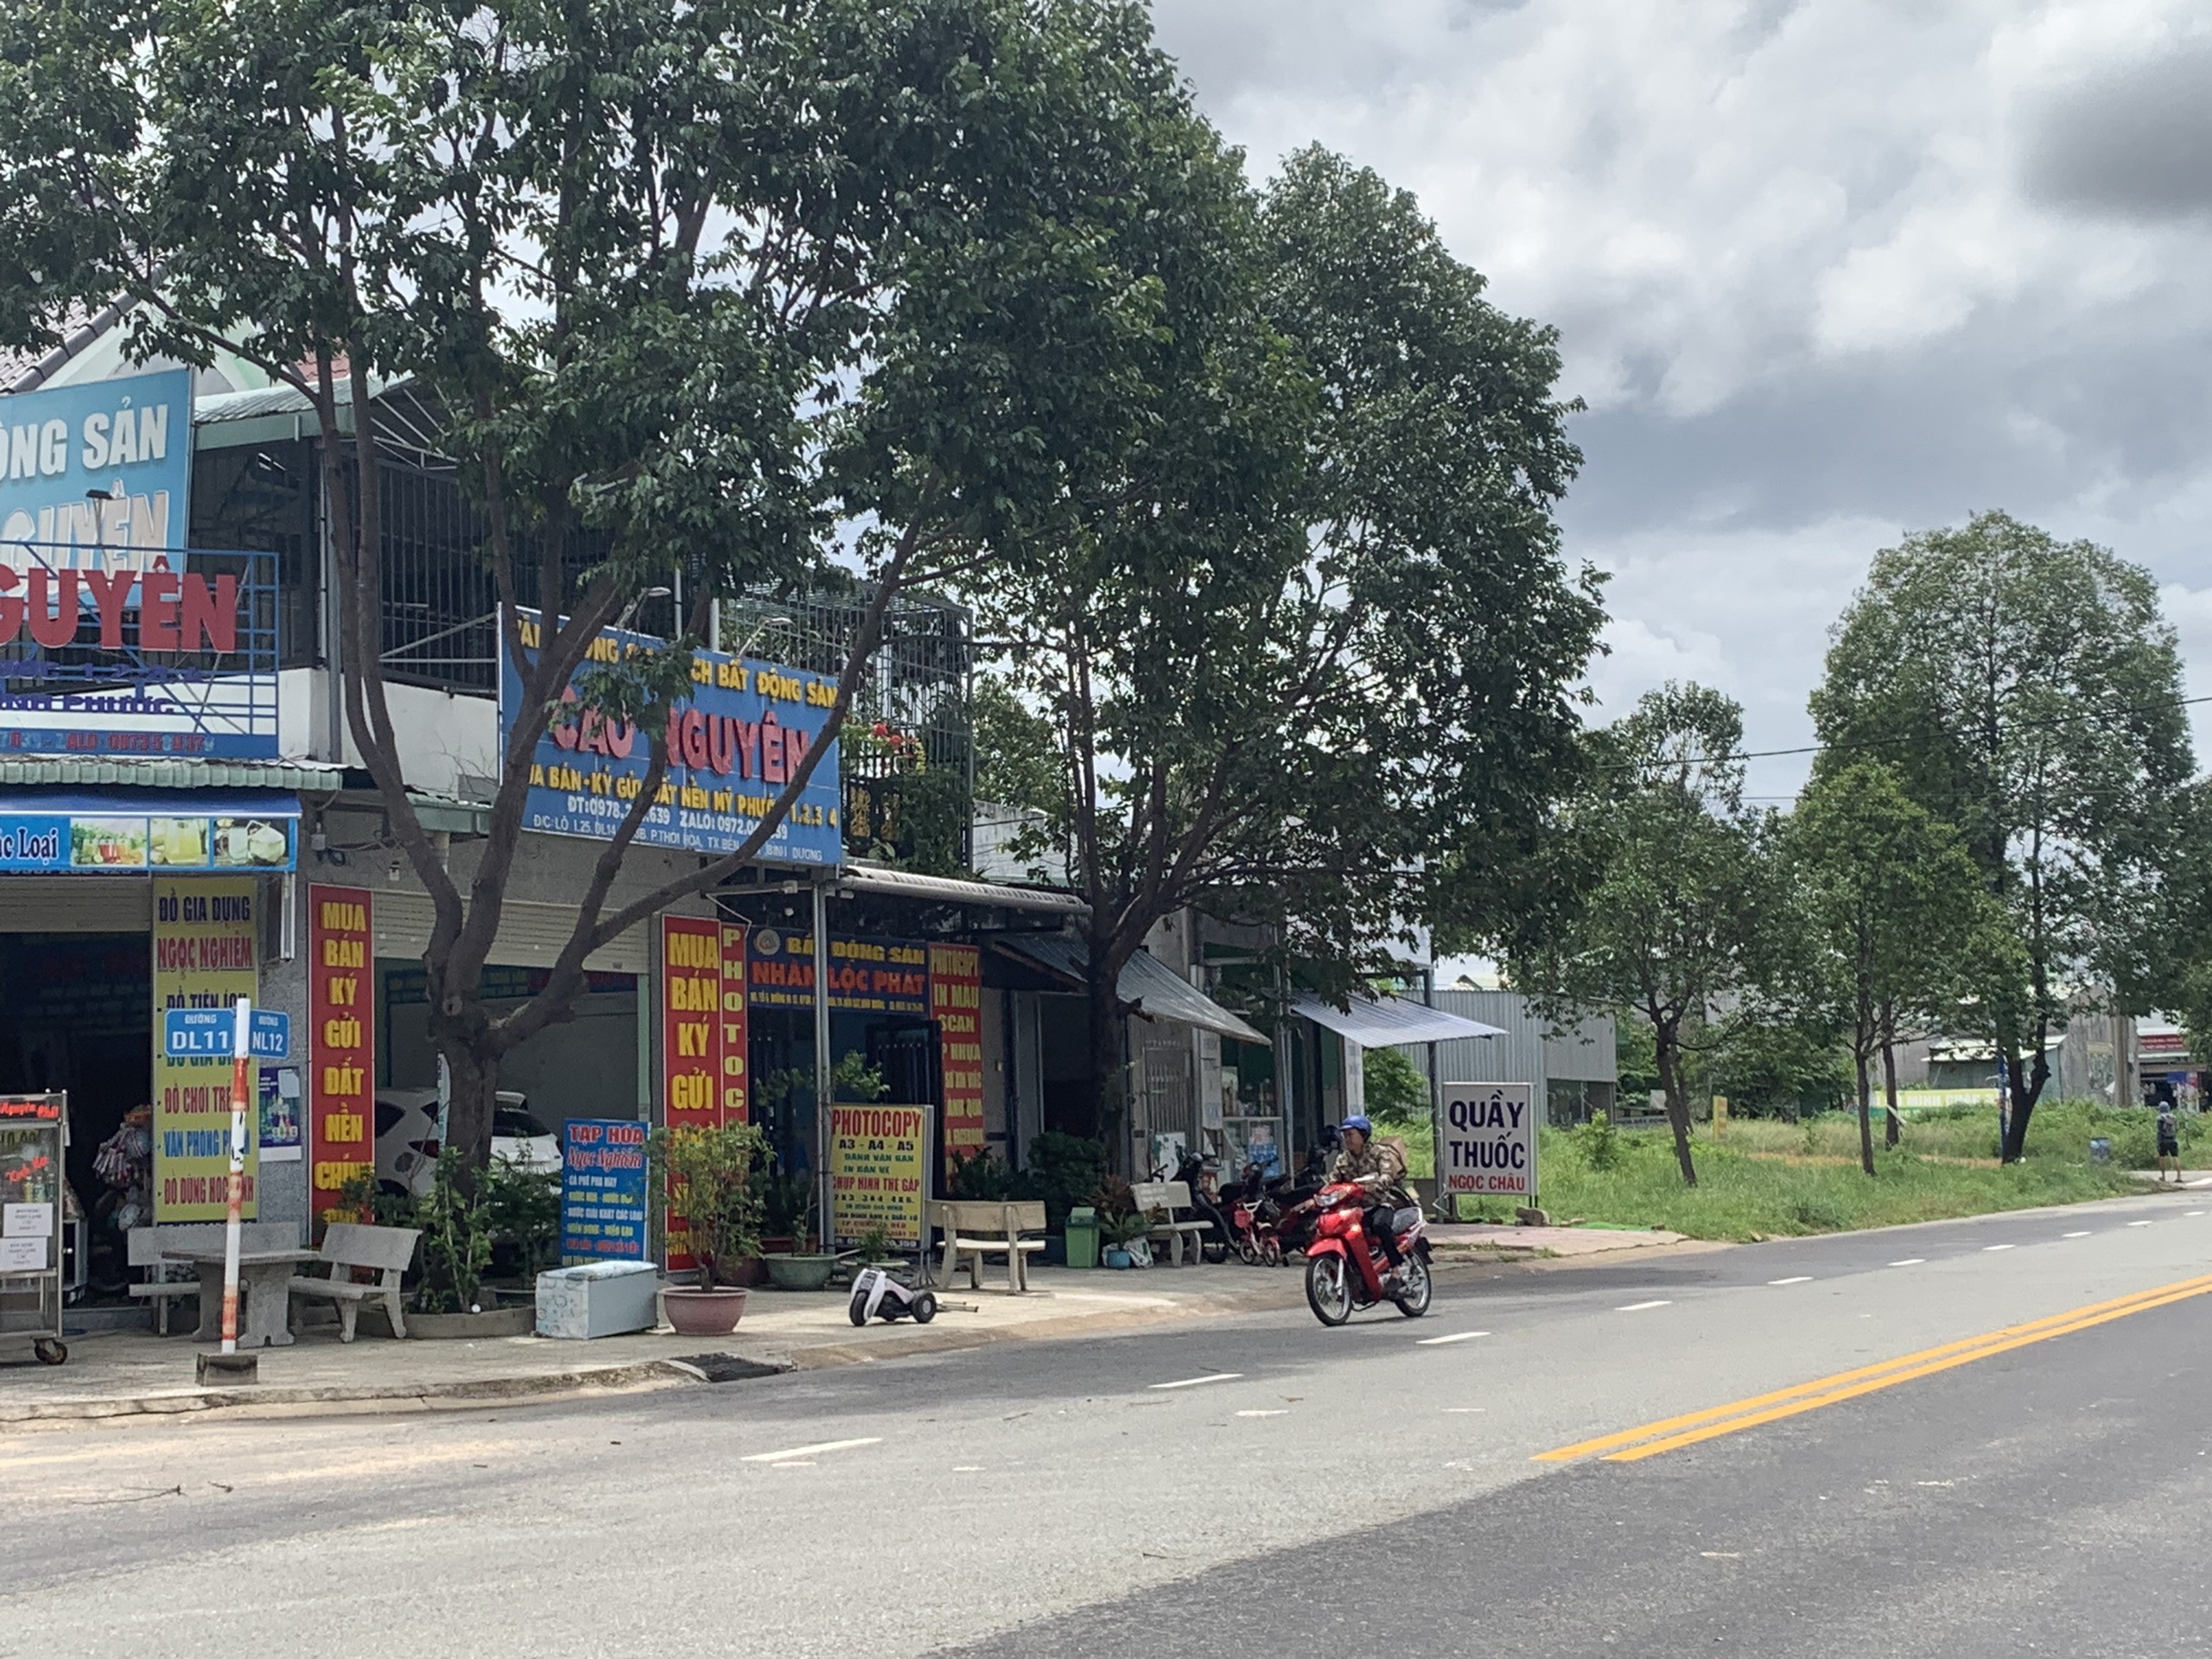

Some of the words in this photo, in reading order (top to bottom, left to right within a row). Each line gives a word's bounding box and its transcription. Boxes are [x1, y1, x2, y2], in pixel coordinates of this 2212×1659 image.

[82, 397, 168, 469] SẢN
[718, 659, 749, 690] BẤT
[758, 668, 802, 702] ĐỘNG
[806, 677, 838, 708] SẢN
[653, 775, 677, 805] ẤT
[681, 775, 709, 810] NỀN
[714, 786, 733, 813] MỸ
[737, 791, 776, 818] PHƯỚ
[0, 831, 14, 859] c
[17, 827, 59, 866] Loại
[183, 896, 207, 922] GIA
[213, 895, 251, 929] DỤNG
[321, 902, 366, 931] MUA
[157, 937, 197, 976] NGỌC
[324, 933, 365, 968] BÁN
[669, 932, 718, 969] MUA
[786, 933, 815, 956] BẤ
[830, 939, 885, 963] ĐỘNG
[888, 944, 925, 965] SẢN
[931, 948, 979, 976] PHOTOCOPY
[224, 988, 247, 1009] ÍC
[329, 973, 357, 1005] KÝ
[671, 969, 717, 1012] BÁN
[934, 983, 947, 1007] IN
[951, 982, 979, 1008] MÀU
[185, 1014, 217, 1025] ĐƯỜNG
[325, 1012, 361, 1048] GỬI
[678, 1014, 710, 1057] KÝ
[938, 1014, 975, 1033] SCAN
[172, 1031, 228, 1050] DL11
[252, 1033, 283, 1052] NL12
[323, 1057, 364, 1095] ĐẤT
[671, 1067, 714, 1109] GỬI
[325, 1102, 363, 1141] NỀN
[831, 1109, 921, 1138] PHOTOCOPY
[1449, 1090, 1525, 1132] QUẦY
[569, 1124, 602, 1146] TẠP
[607, 1123, 645, 1145] HÓA
[839, 1140, 855, 1150] A3
[868, 1140, 884, 1150] A4
[897, 1141, 914, 1151] A5
[1449, 1132, 1525, 1169] THUỐC
[1448, 1174, 1484, 1192] NGỌC
[1489, 1173, 1525, 1192] CHÂU
